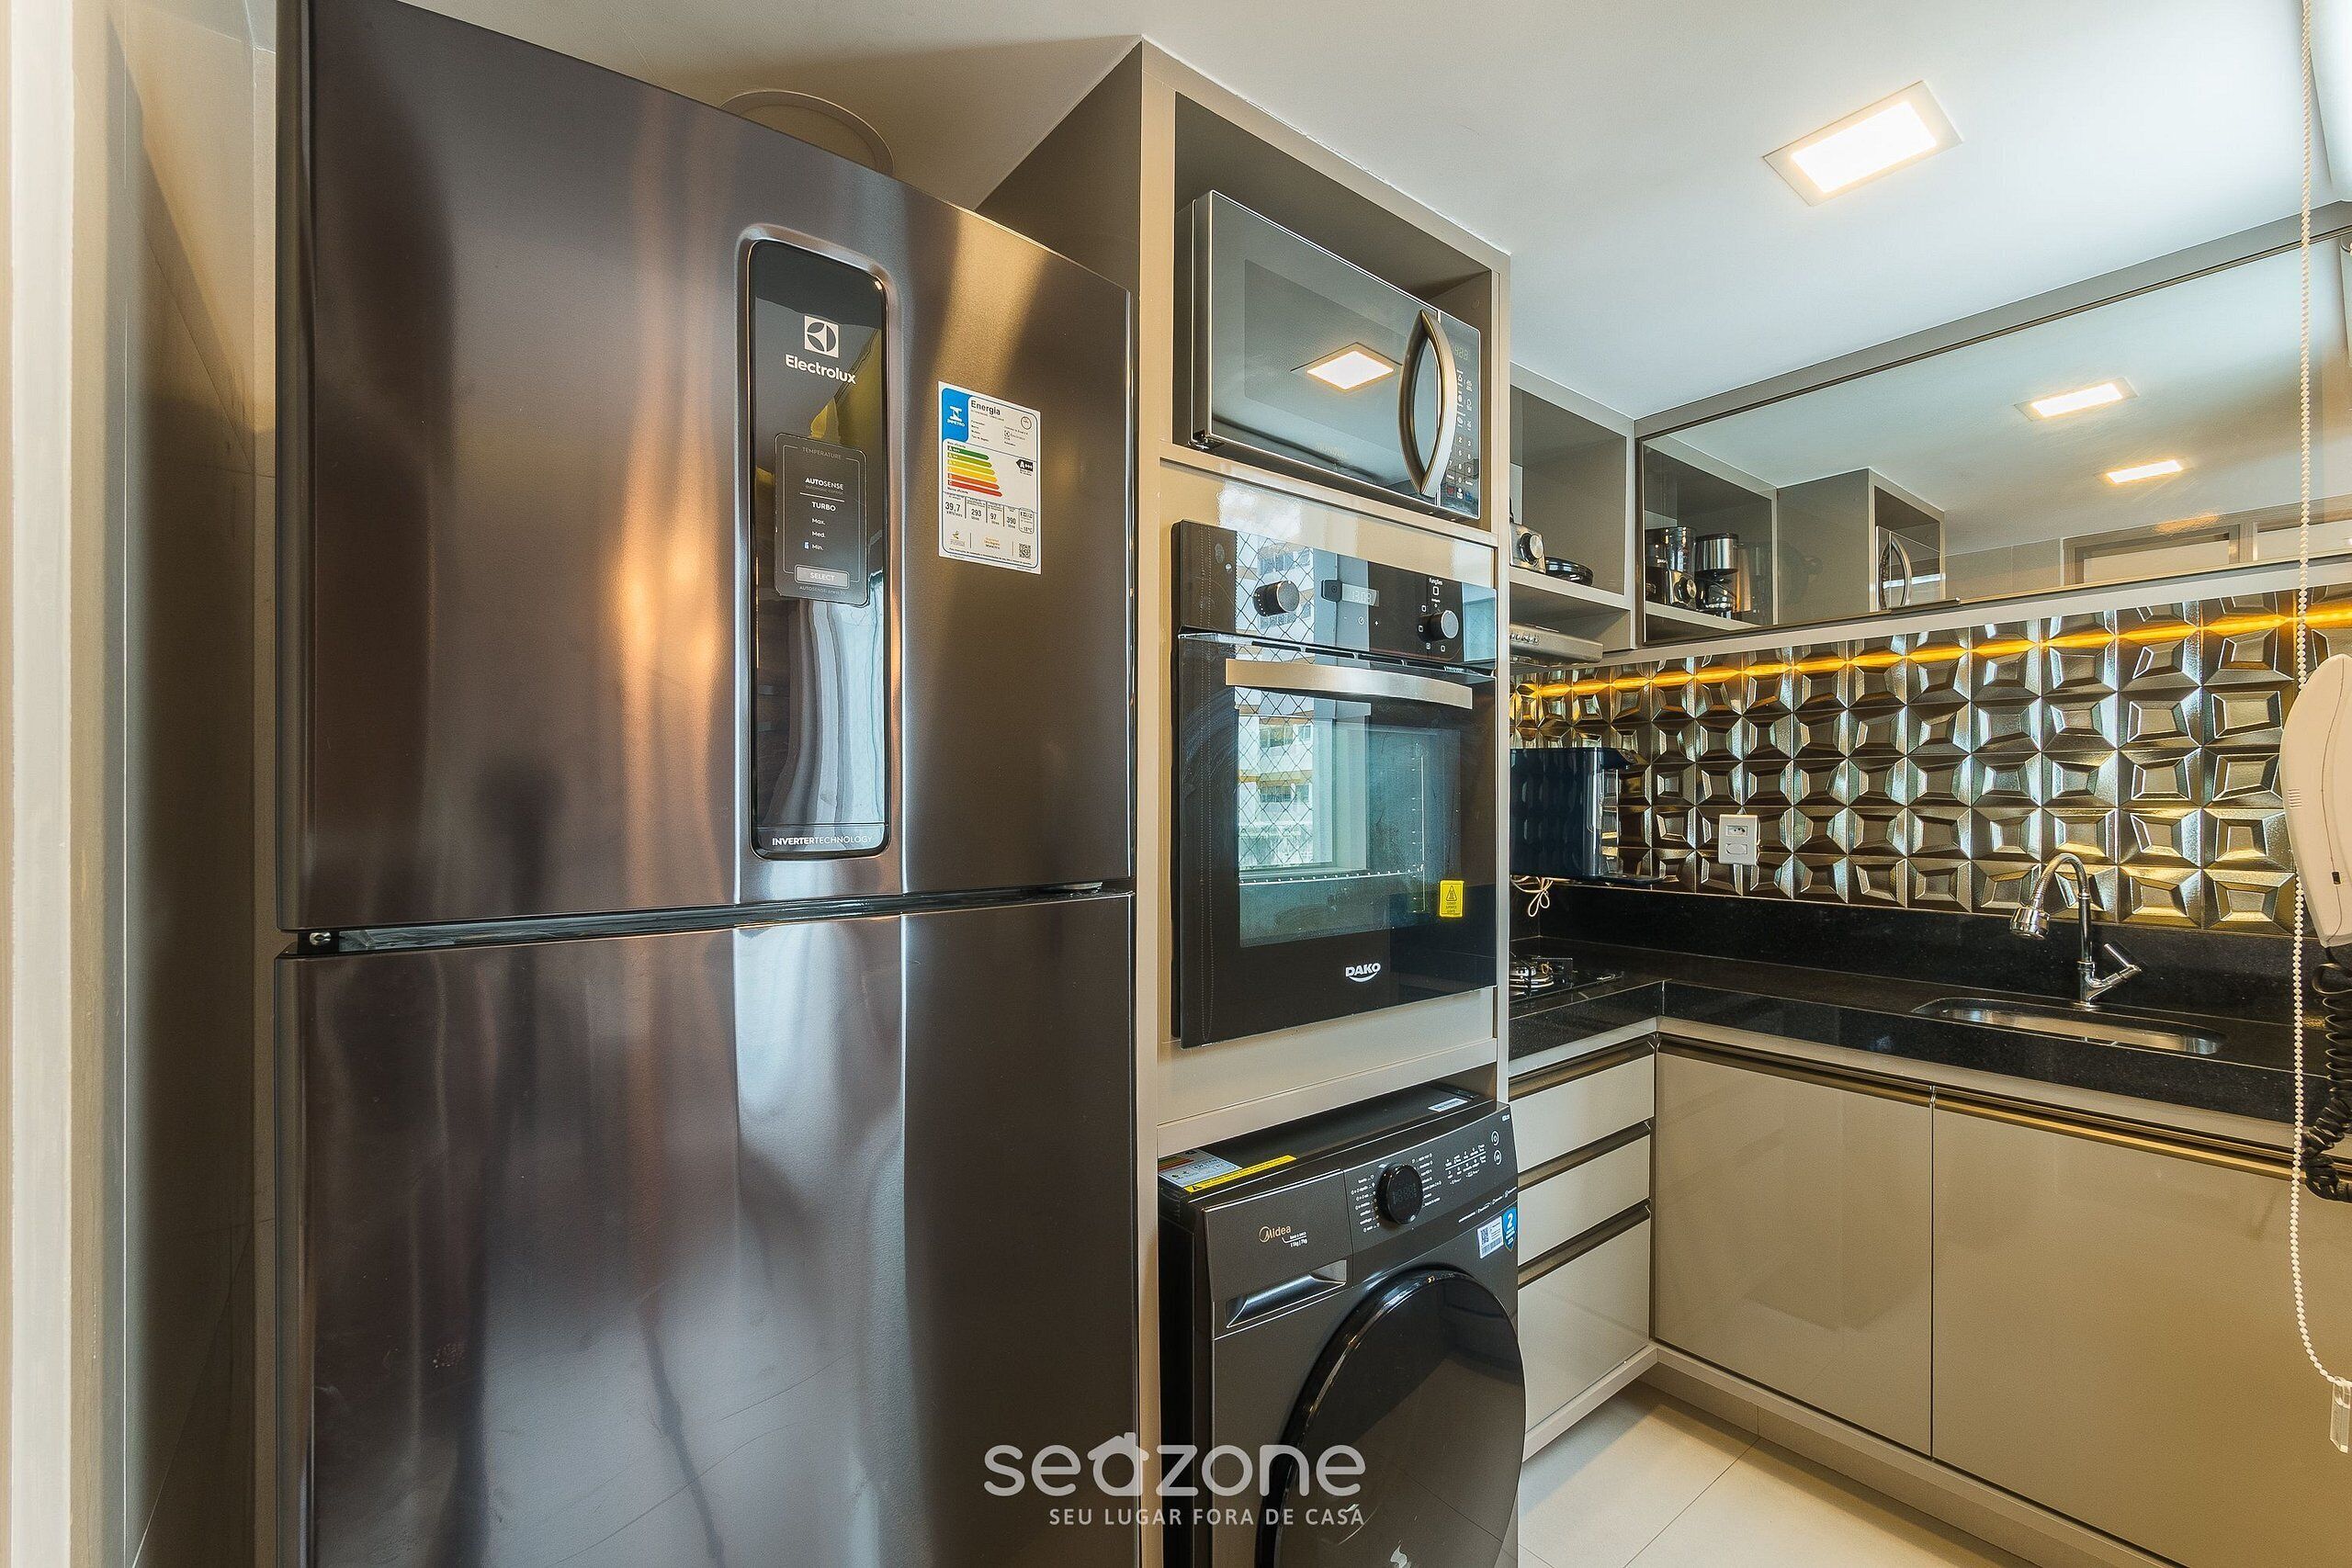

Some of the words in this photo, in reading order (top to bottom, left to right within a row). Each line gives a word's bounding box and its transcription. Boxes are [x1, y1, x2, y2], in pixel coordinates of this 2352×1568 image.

[785, 354, 856, 385] Electrolux
[970, 400, 1001, 416] Energia
[802, 446, 842, 460] TEMPERATURE
[805, 477, 844, 491] AUTOSENSE
[811, 502, 837, 512] TURBO
[970, 508, 982, 517] 293
[811, 517, 826, 525] Max.
[811, 543, 824, 551] Min.
[809, 571, 836, 581] SELECT
[1345, 963, 1382, 977] DAKO
[1259, 1225, 1292, 1243] Midea
